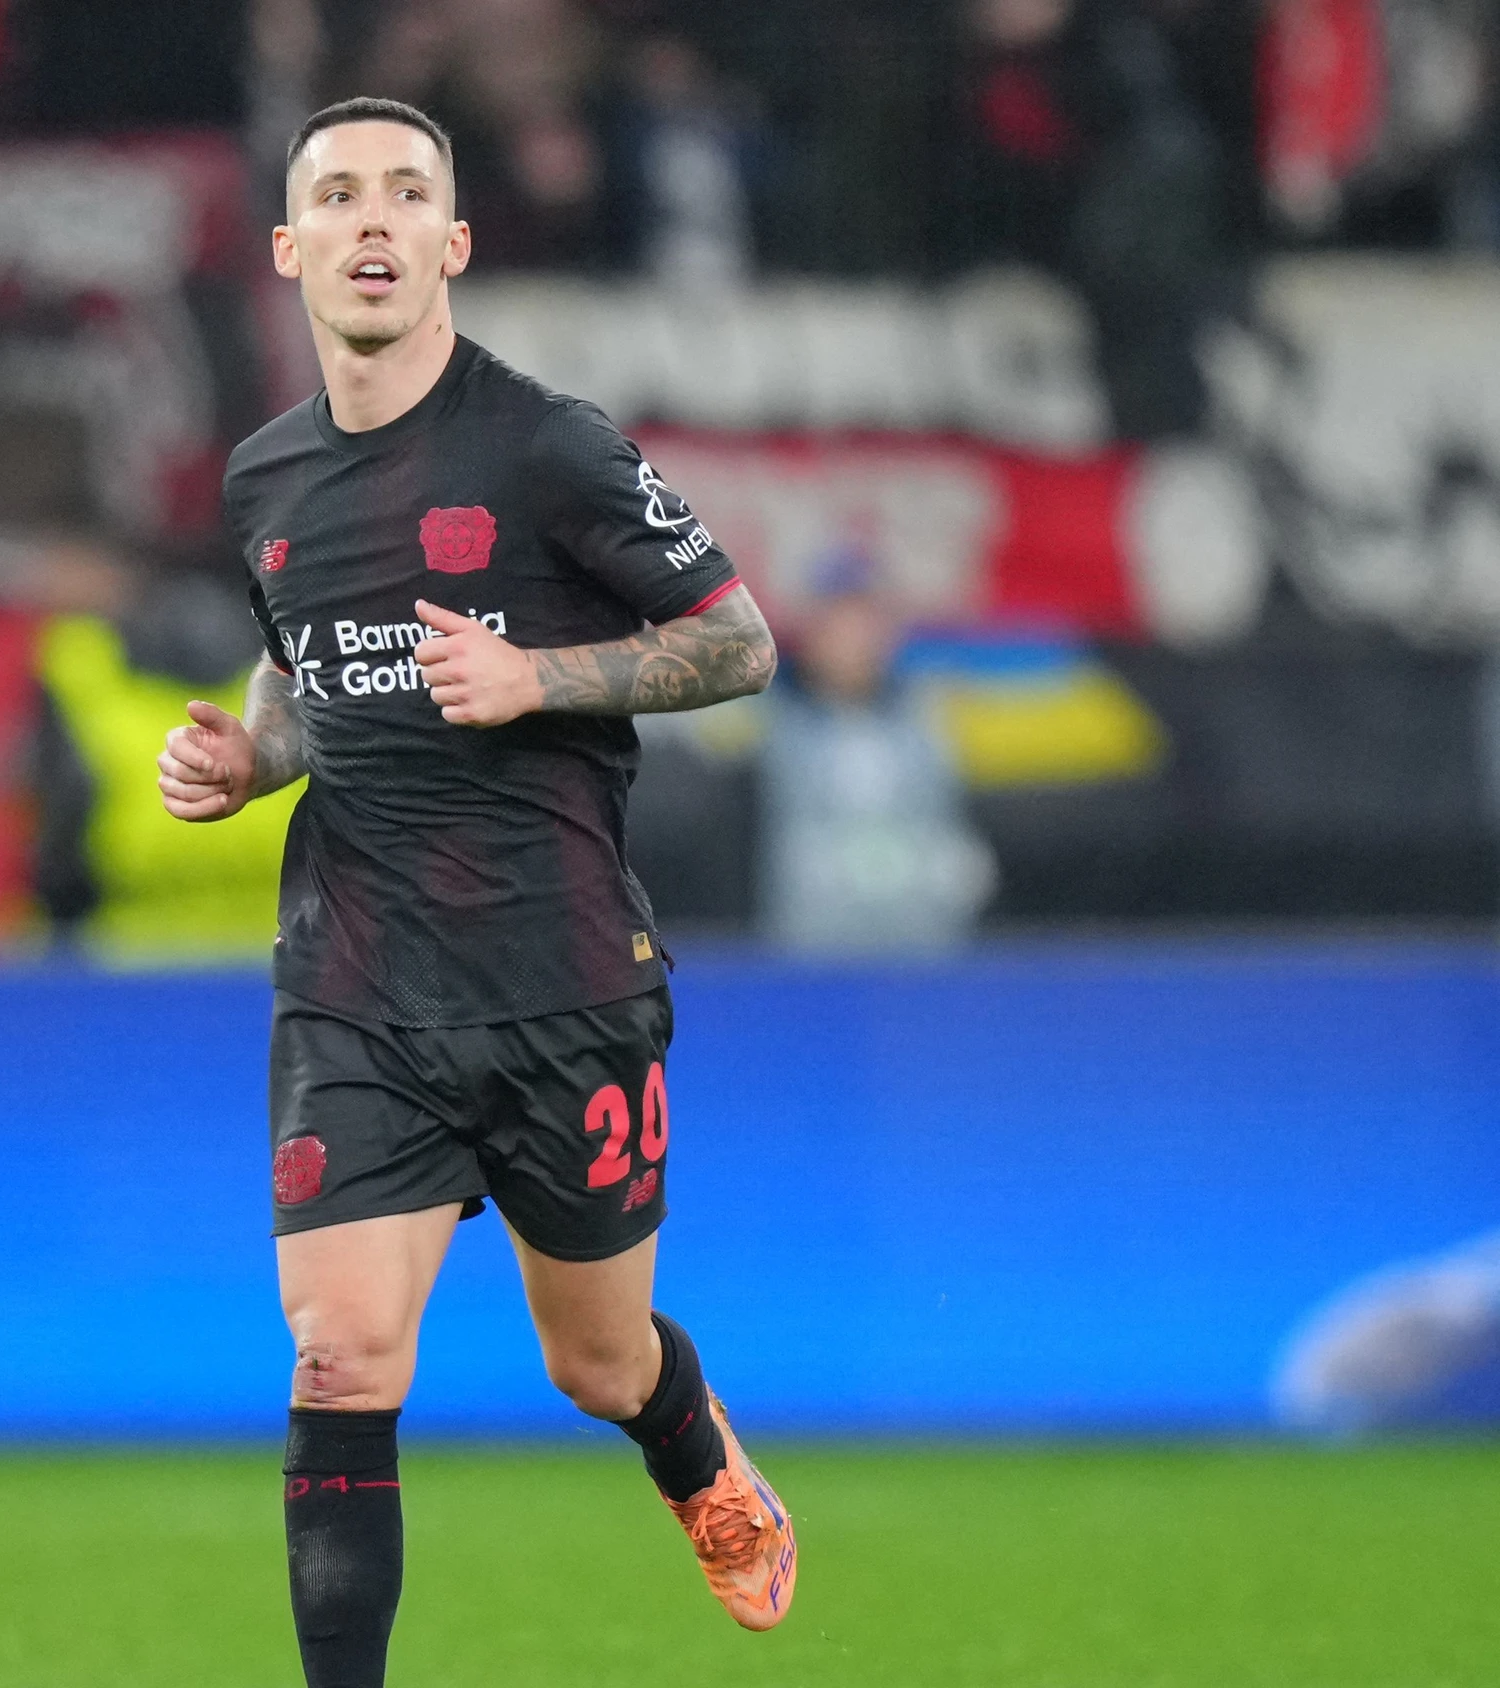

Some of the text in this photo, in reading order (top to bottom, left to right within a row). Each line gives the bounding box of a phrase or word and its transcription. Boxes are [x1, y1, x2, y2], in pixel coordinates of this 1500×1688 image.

[665, 521, 713, 571] NIED
[334, 608, 507, 655] Barmea
[341, 656, 430, 697] Goth
[584, 1061, 669, 1188] 20
